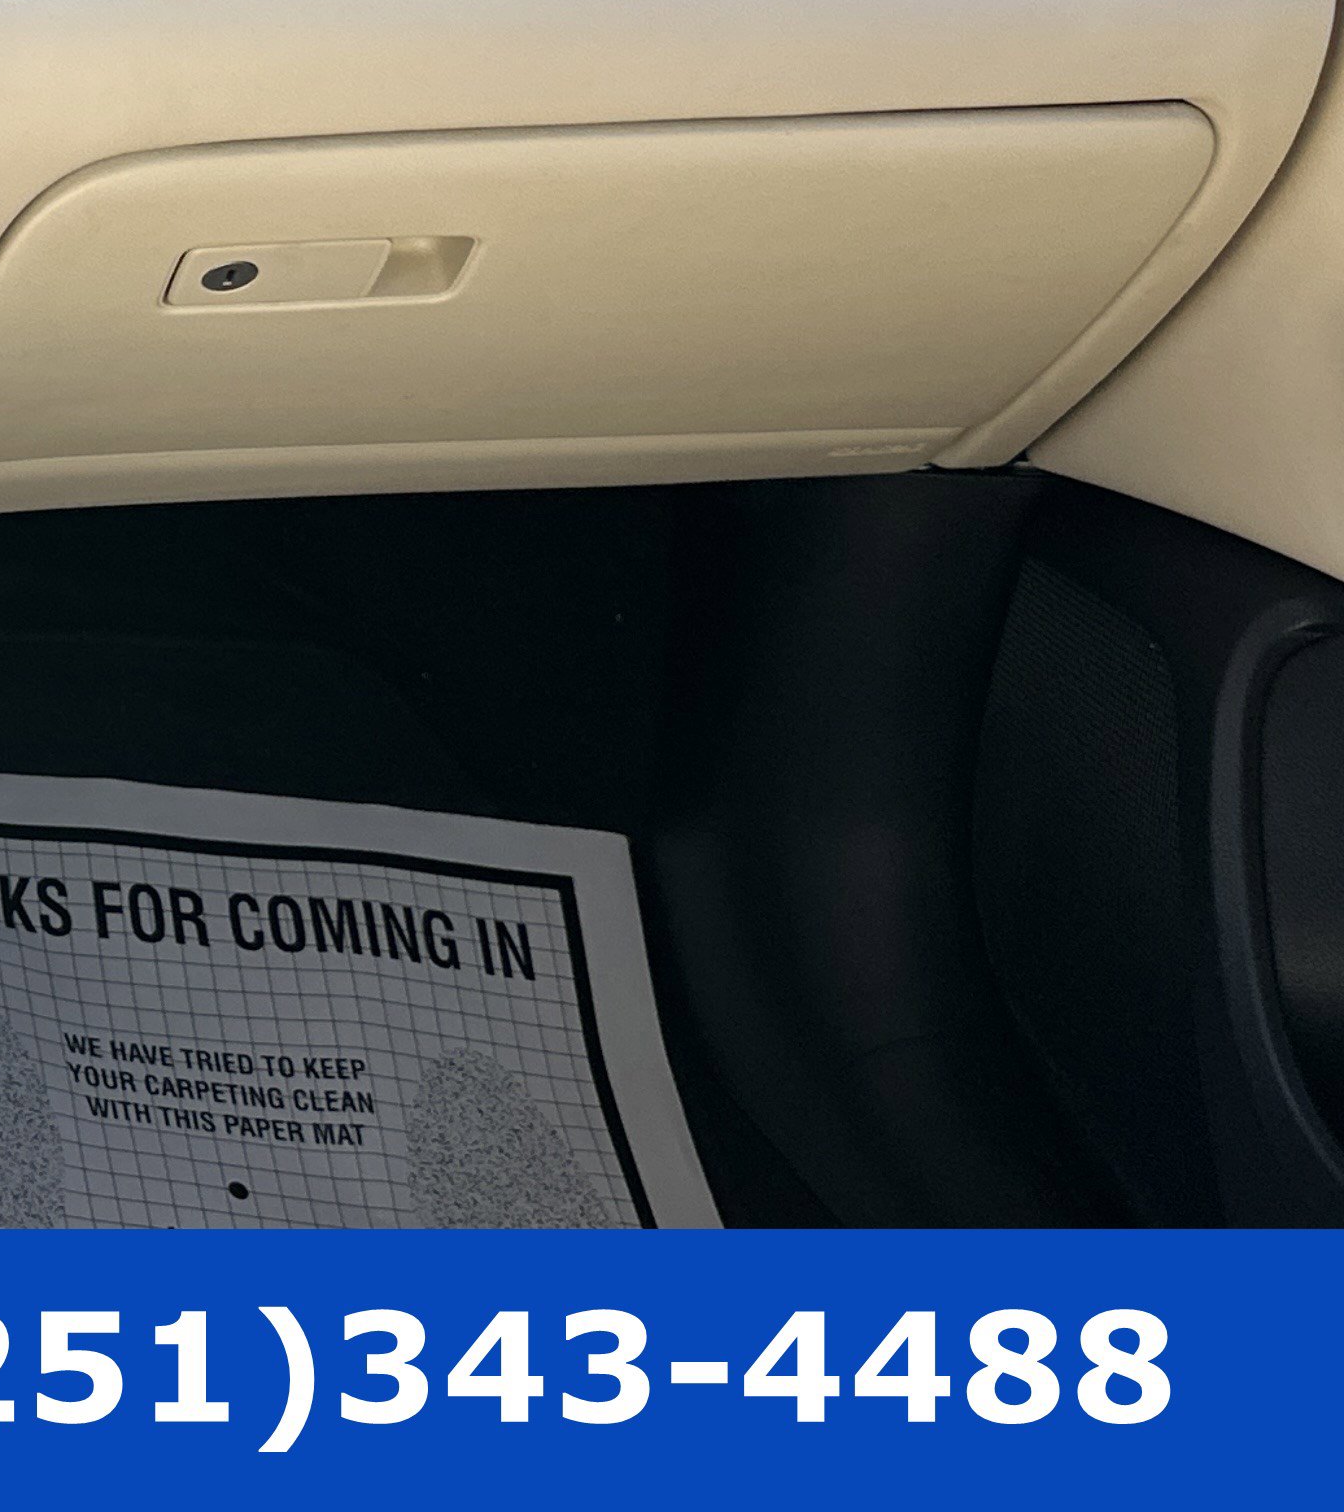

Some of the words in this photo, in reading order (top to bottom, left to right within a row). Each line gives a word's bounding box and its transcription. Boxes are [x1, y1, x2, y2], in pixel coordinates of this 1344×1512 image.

[92, 880, 210, 947] FOR
[228, 892, 461, 970] COMING
[475, 916, 537, 982] IN
[63, 1032, 103, 1059] WE
[109, 1039, 175, 1067] HAVE
[179, 1047, 254, 1076] TRIED
[260, 1054, 295, 1079] TO
[302, 1056, 367, 1081] KEEP
[66, 1061, 138, 1093] YOUR
[143, 1073, 286, 1110] CARPETING
[292, 1088, 376, 1114] CLEAN
[84, 1095, 153, 1125] WITH
[160, 1105, 216, 1133] THIS
[223, 1113, 305, 1143] PAPER
[312, 1122, 365, 1147] MAT
